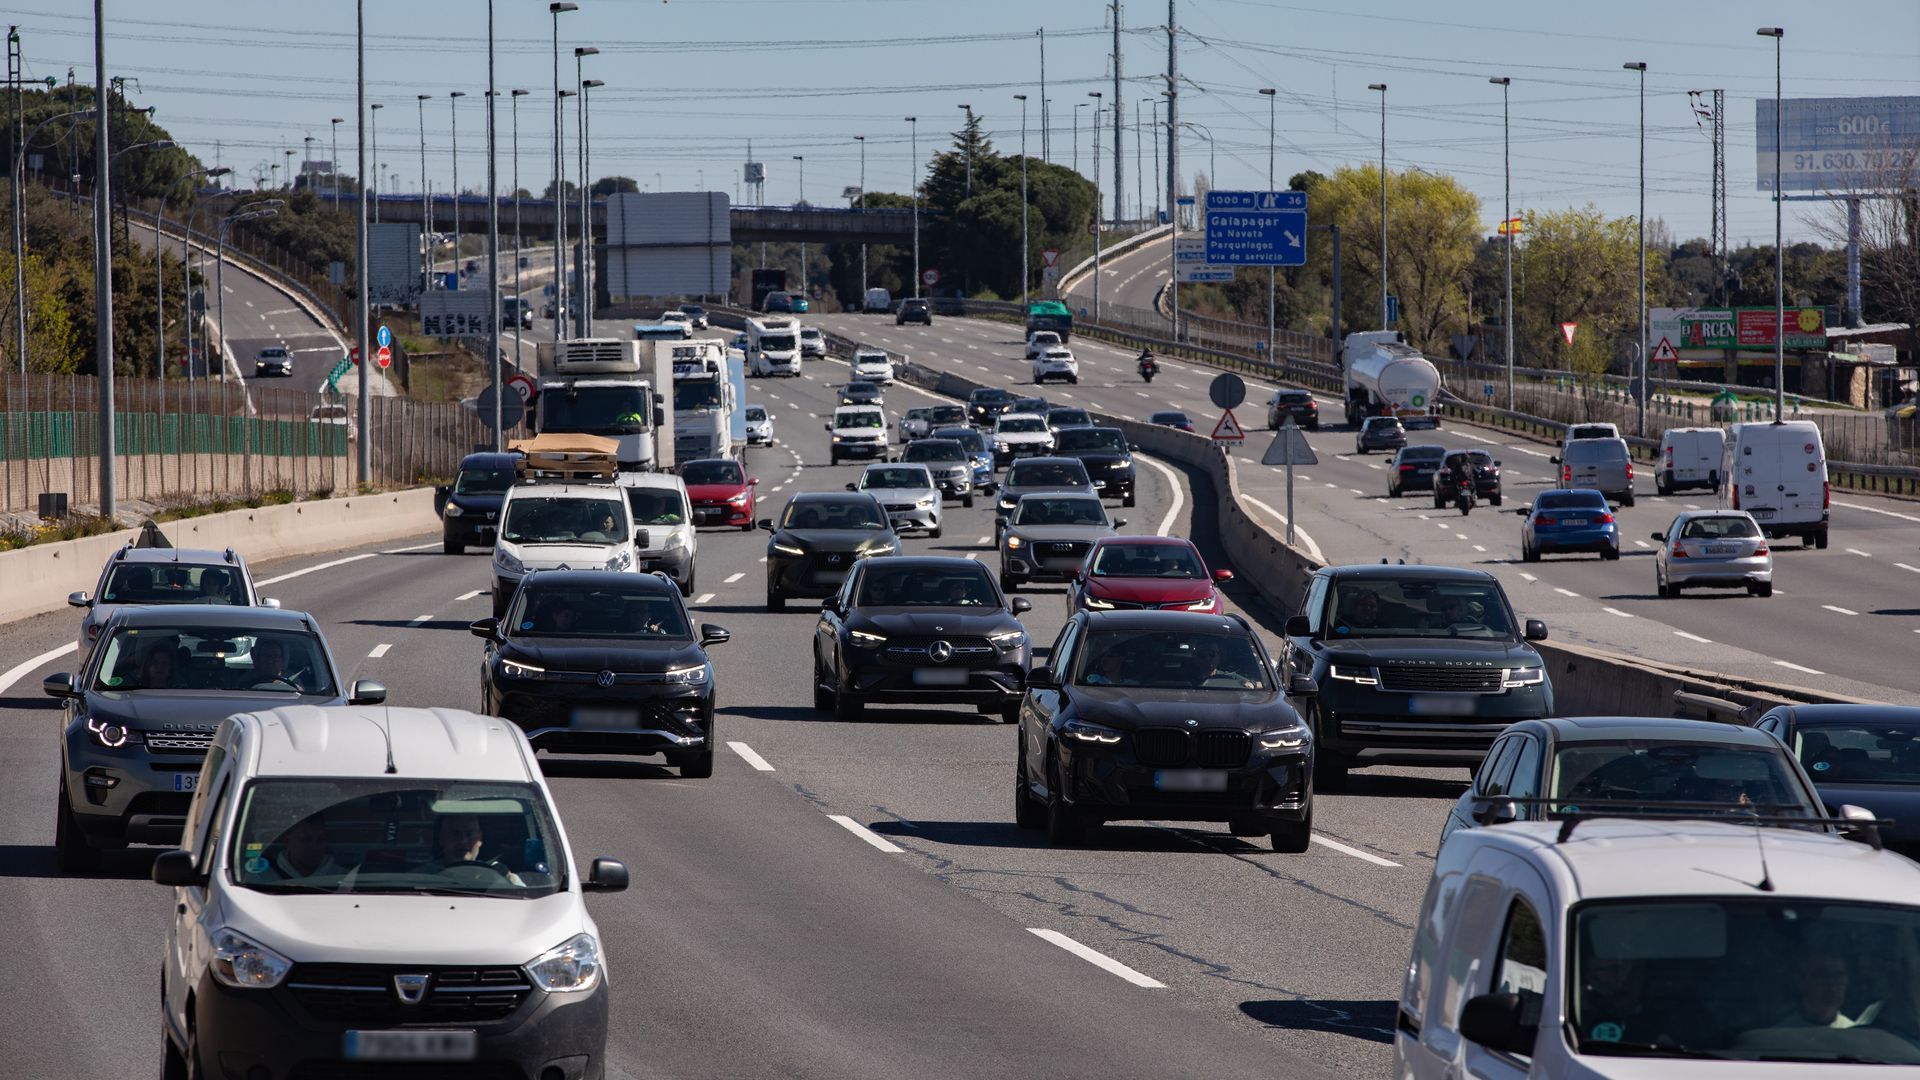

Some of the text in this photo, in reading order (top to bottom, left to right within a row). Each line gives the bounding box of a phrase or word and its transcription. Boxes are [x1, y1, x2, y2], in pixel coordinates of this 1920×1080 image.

[1212, 196, 1239, 205] 1000
[1288, 196, 1302, 205] 36
[1211, 216, 1280, 229] Galapagar
[1210, 229, 1223, 238] La
[1210, 241, 1273, 250] Parquelagos
